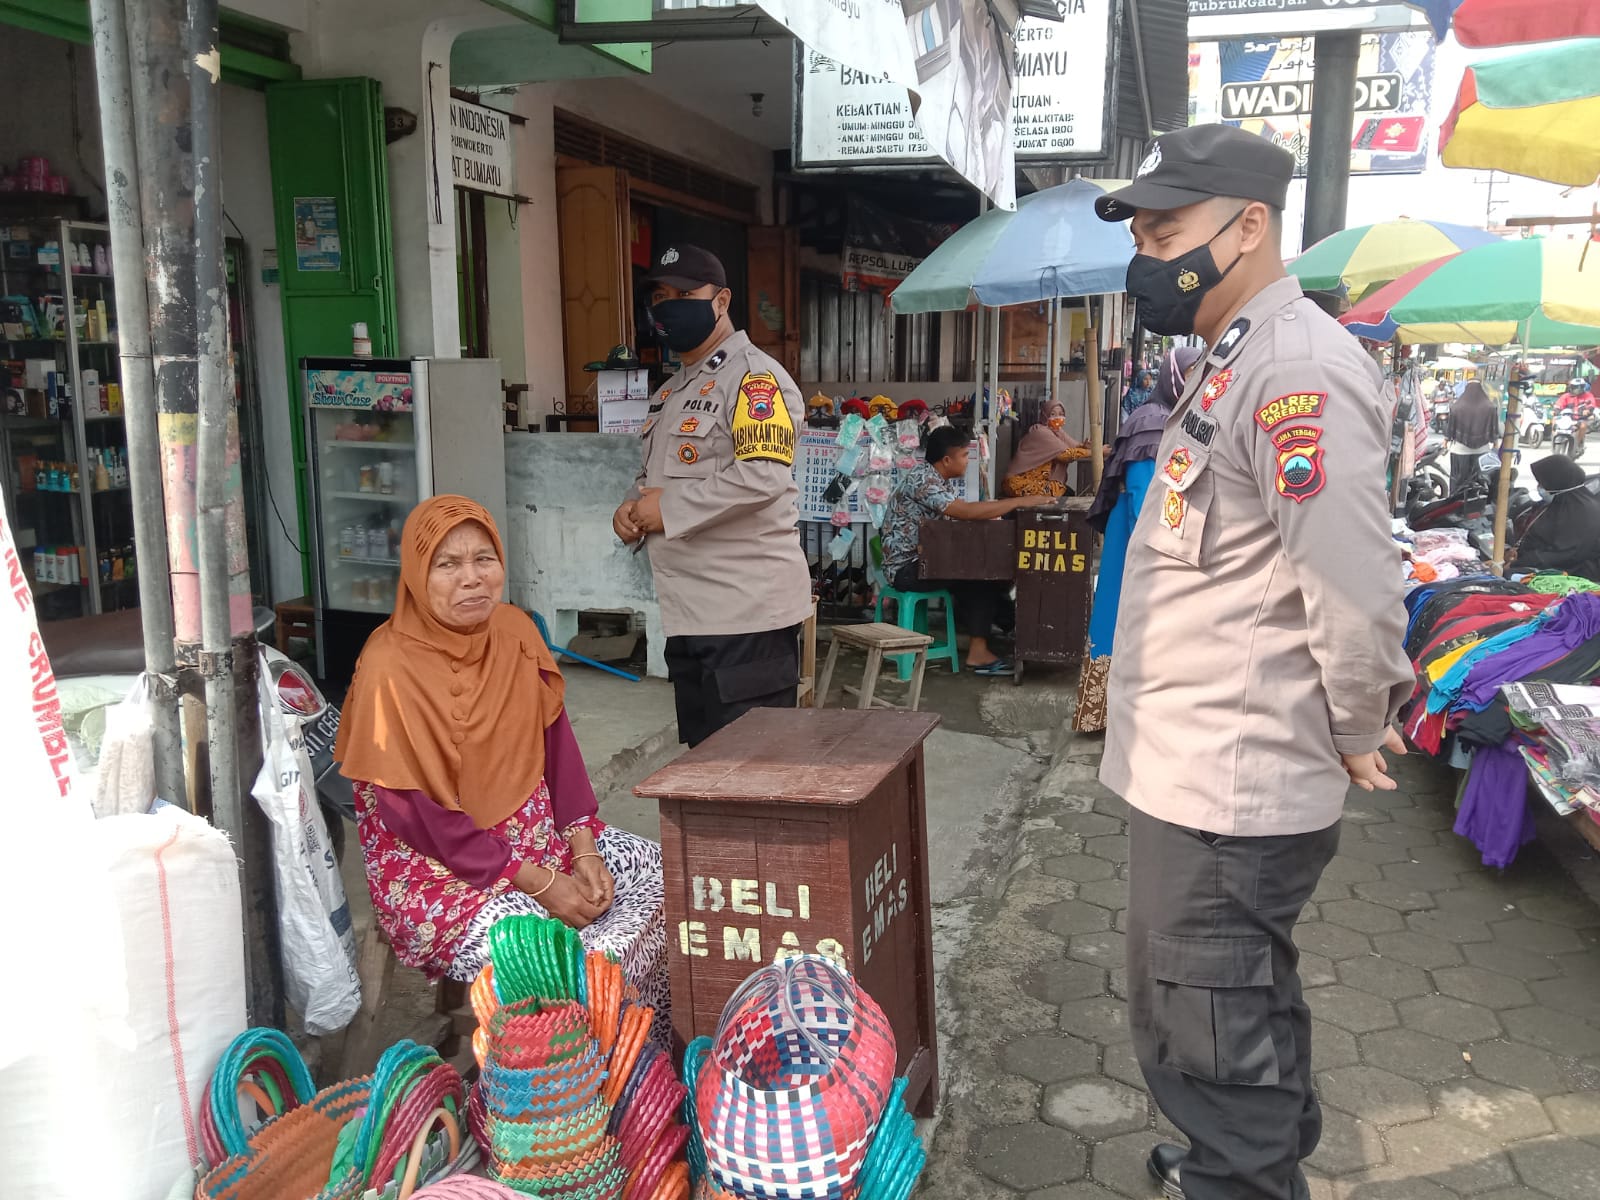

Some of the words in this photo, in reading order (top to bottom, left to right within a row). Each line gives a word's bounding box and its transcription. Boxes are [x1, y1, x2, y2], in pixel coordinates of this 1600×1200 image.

[1227, 79, 1392, 116] WADIOR
[459, 107, 506, 141] INDONESIA
[871, 121, 905, 130] MINGGU
[1014, 127, 1049, 136] SELASA
[870, 132, 904, 142] MINGGU
[464, 158, 502, 187] BUMIAYU
[849, 252, 890, 269] REPSOL
[683, 400, 719, 413] POLRI
[1260, 395, 1319, 422] POLRES
[1267, 405, 1313, 425] BREBES
[1023, 529, 1078, 551] BELI
[1018, 551, 1086, 573] EMAS
[692, 875, 812, 920] BELI
[860, 878, 908, 966] EMAS
